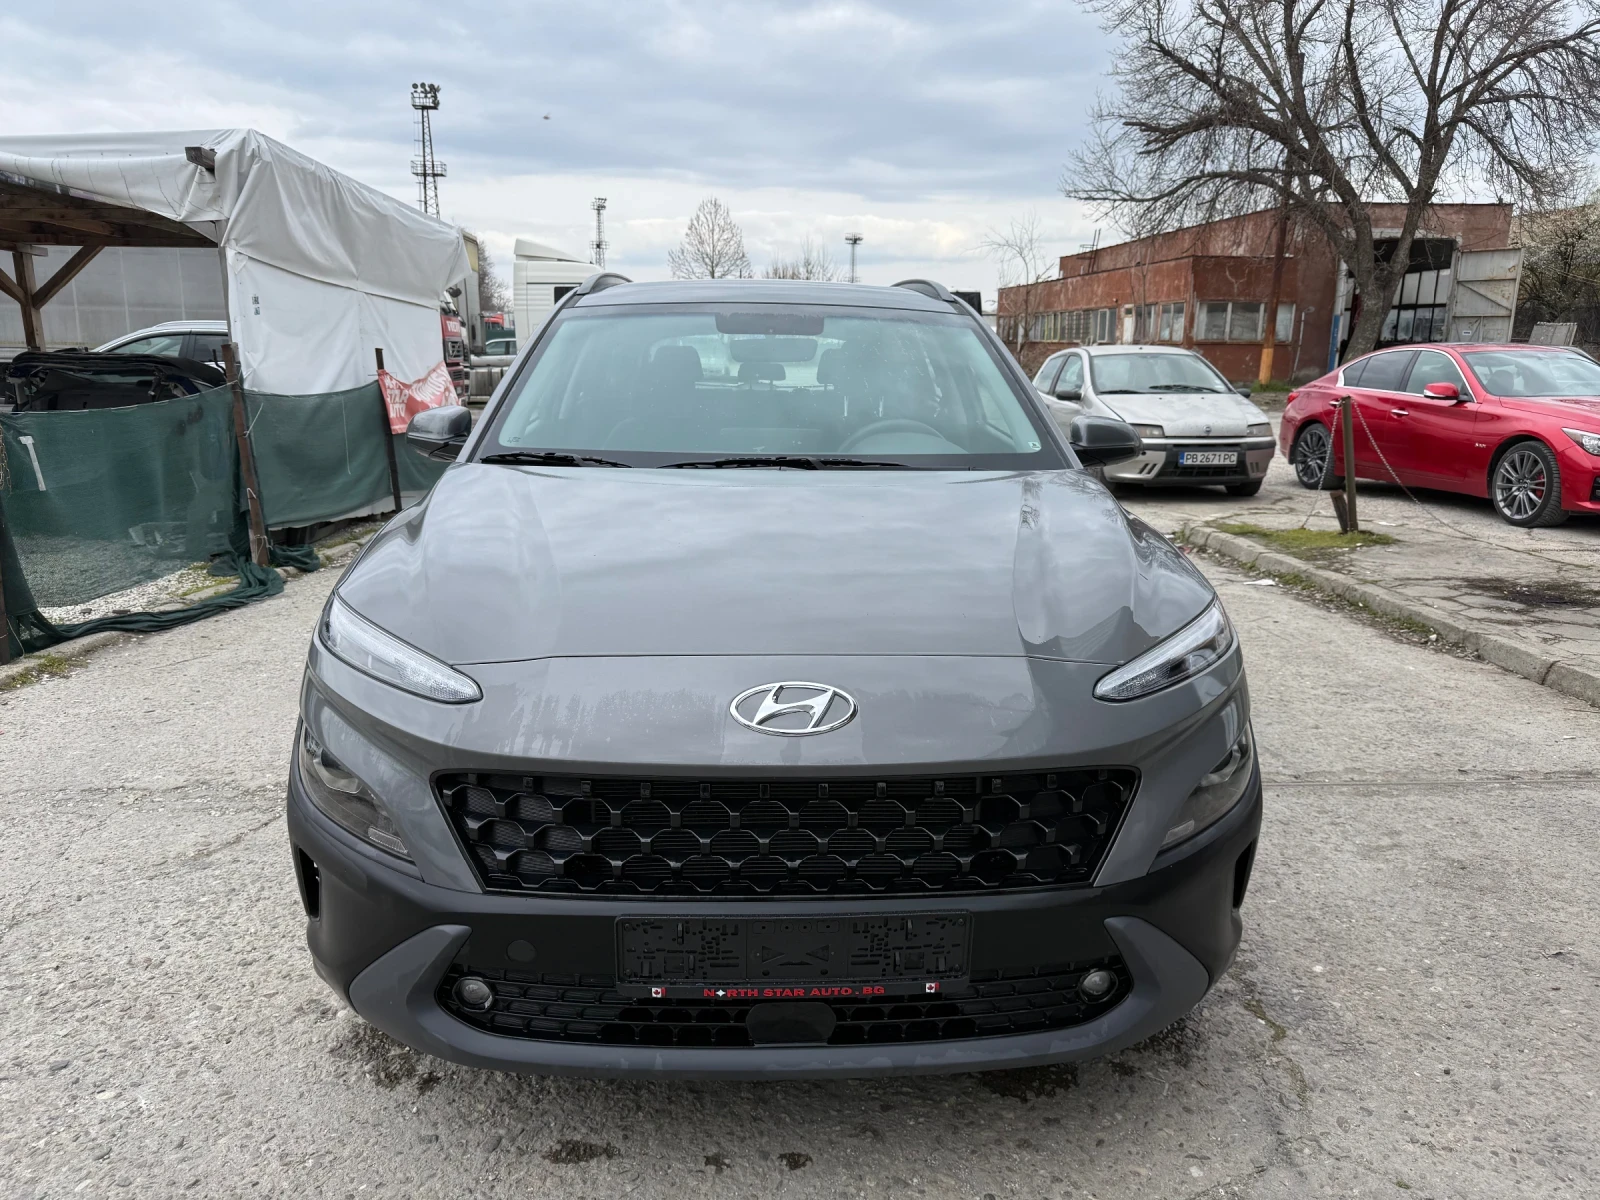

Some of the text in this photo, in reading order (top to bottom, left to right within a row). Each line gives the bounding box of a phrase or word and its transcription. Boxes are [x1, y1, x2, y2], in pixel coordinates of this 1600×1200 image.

[1185, 454, 1236, 463] PB 2671 PC
[703, 988, 759, 998] NRTH
[763, 987, 805, 997] STAR
